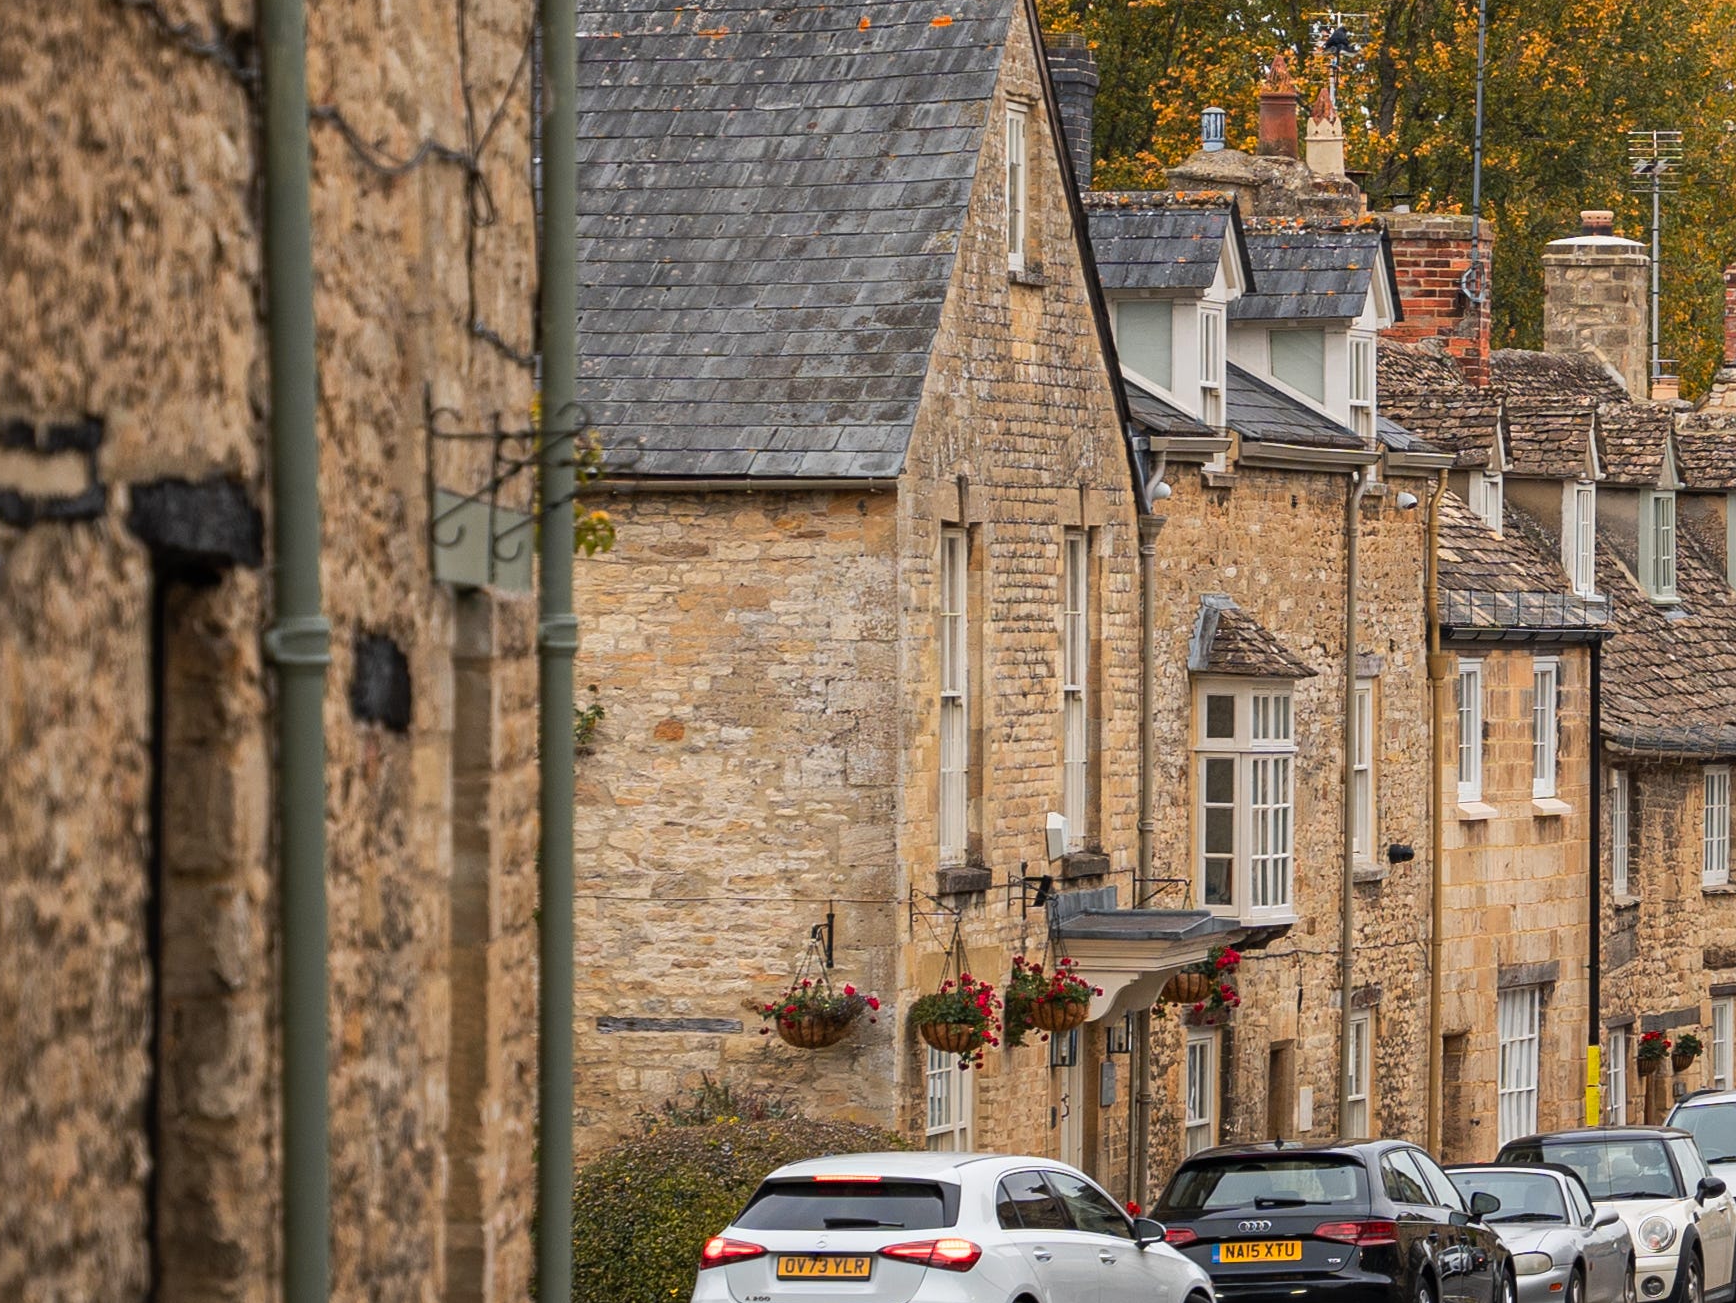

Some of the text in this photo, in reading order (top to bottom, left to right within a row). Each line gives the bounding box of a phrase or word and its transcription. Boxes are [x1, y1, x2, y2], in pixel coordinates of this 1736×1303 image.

[1225, 1242, 1295, 1258] NA15 XTU
[785, 1258, 865, 1274] OV73 YLR
